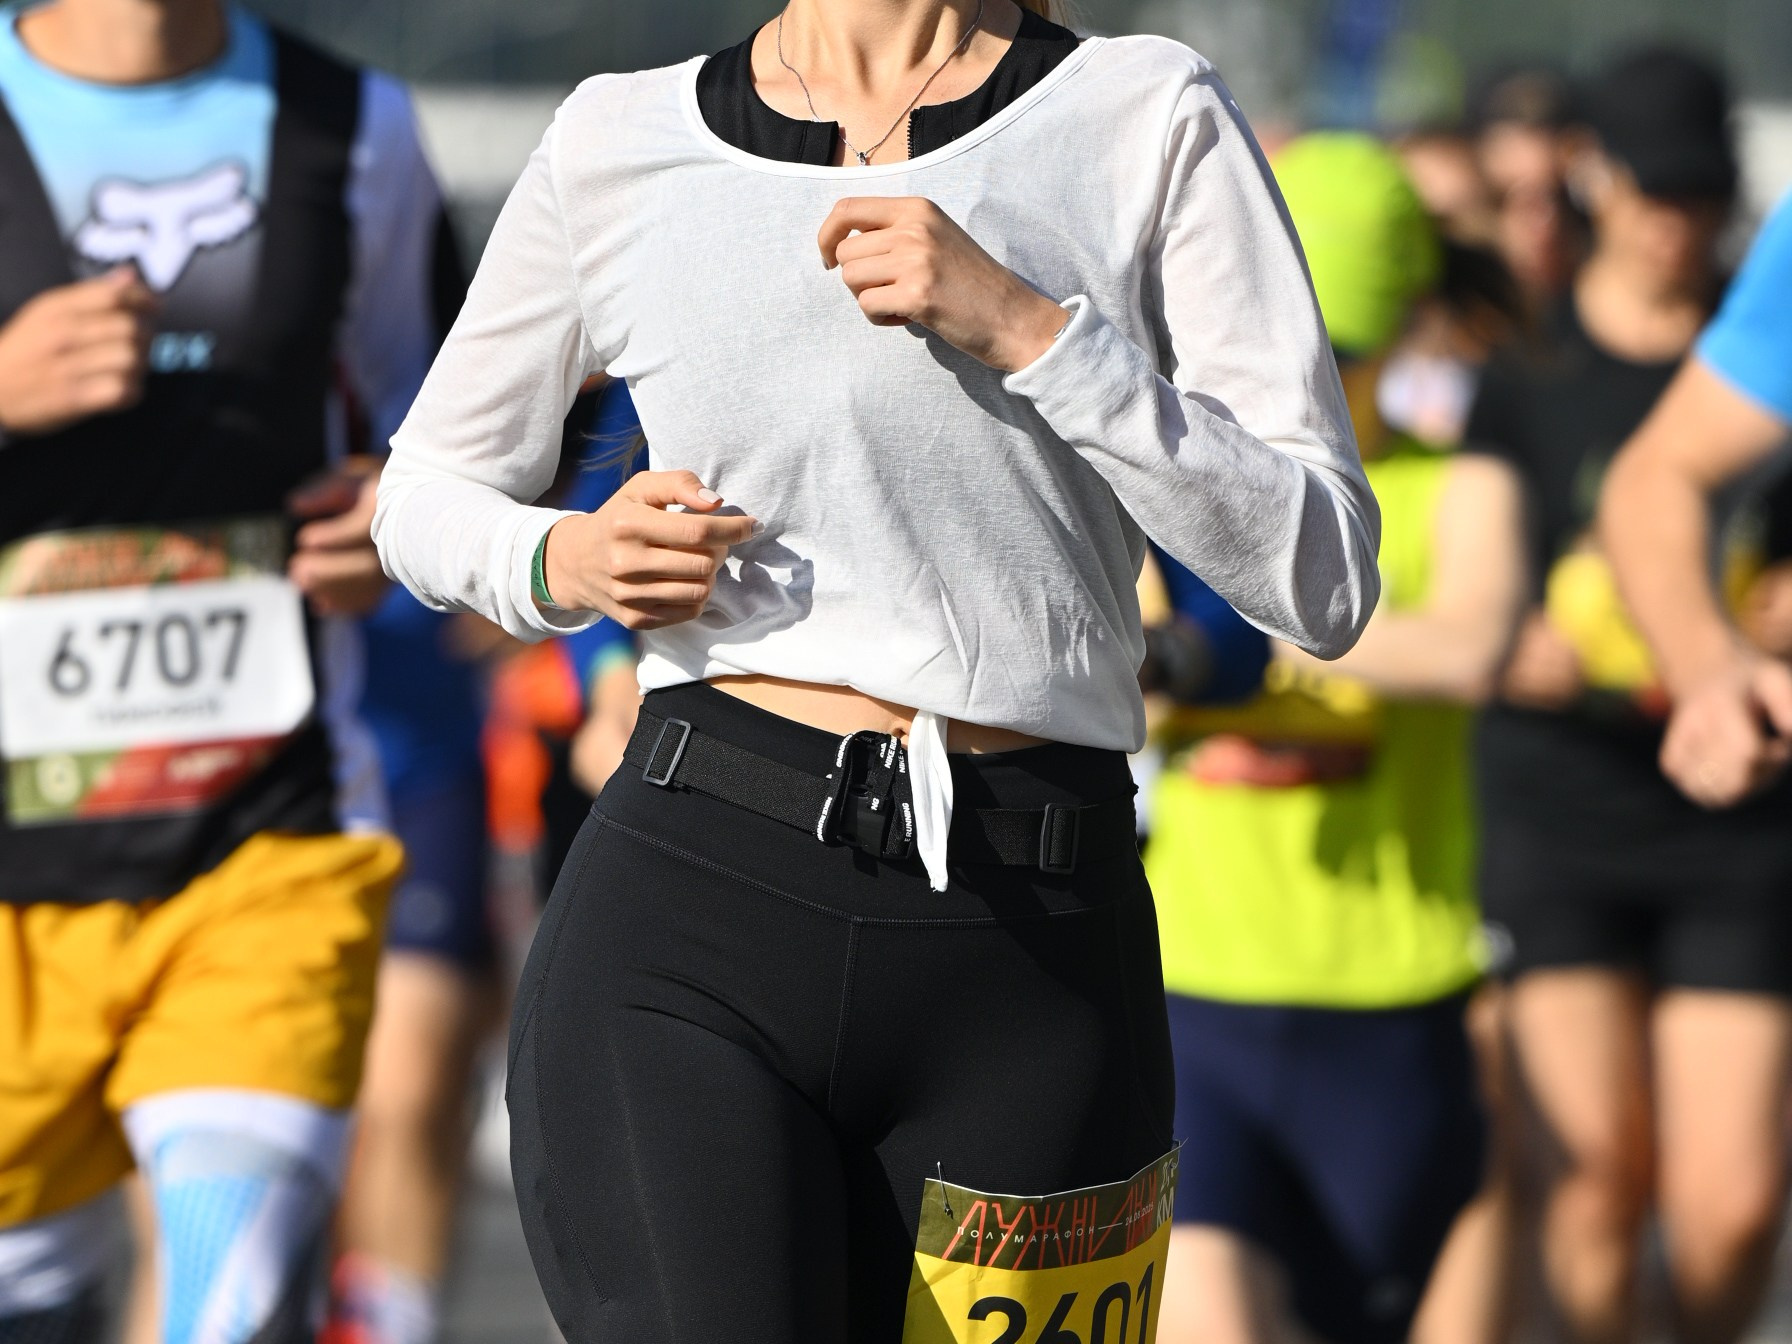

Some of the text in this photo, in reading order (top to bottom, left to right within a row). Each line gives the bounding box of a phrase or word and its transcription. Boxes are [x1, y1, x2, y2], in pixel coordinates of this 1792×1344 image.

[50, 608, 248, 697] 6707
[884, 749, 896, 769] NIKE
[898, 755, 906, 774] NIKE
[902, 802, 913, 838] RUNNING
[956, 1225, 1095, 1244] ПОЛУМАРАФОН
